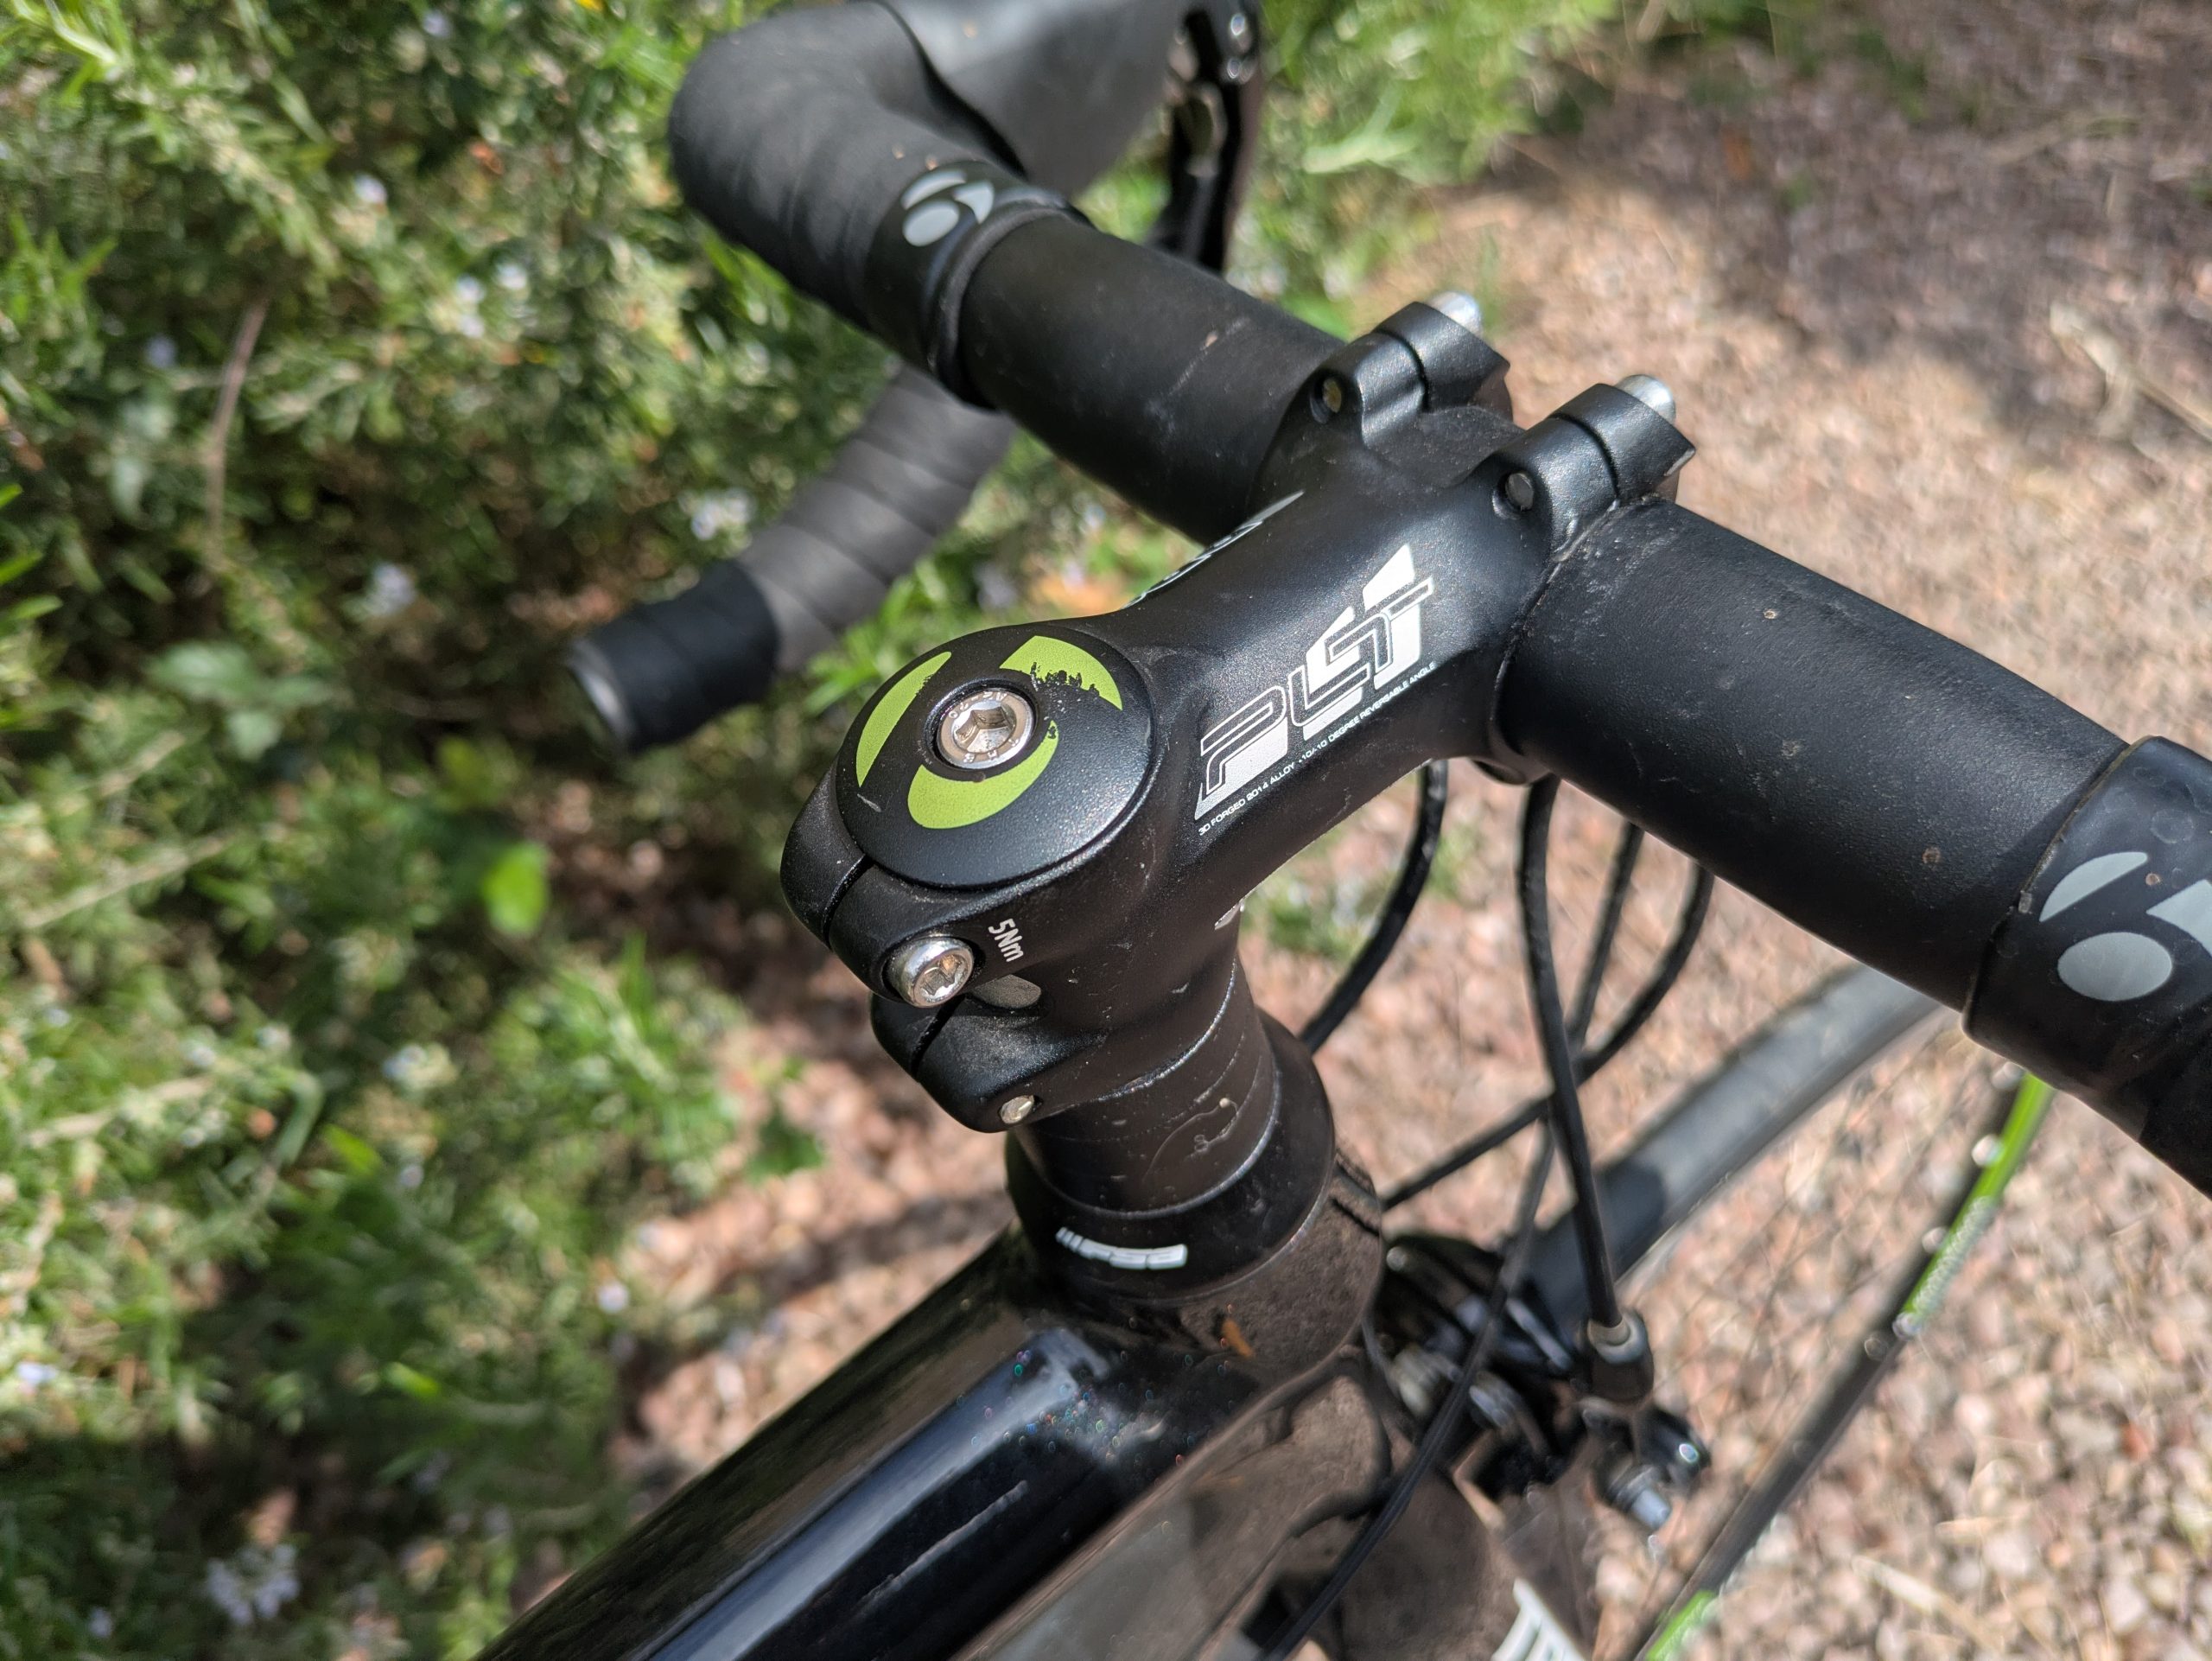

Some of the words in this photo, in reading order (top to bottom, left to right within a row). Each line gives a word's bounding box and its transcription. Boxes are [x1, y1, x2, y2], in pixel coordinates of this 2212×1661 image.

[1198, 823, 1211, 836] 3D
[1211, 798, 1246, 826] FORGED
[1246, 781, 1268, 801] 2014
[1269, 761, 1295, 785] ALLOY
[1327, 716, 1361, 743] DEGREE
[1359, 680, 1409, 721] REVERSABLE
[1409, 660, 1437, 684] ANGLE
[988, 918, 1024, 963] 5Nm
